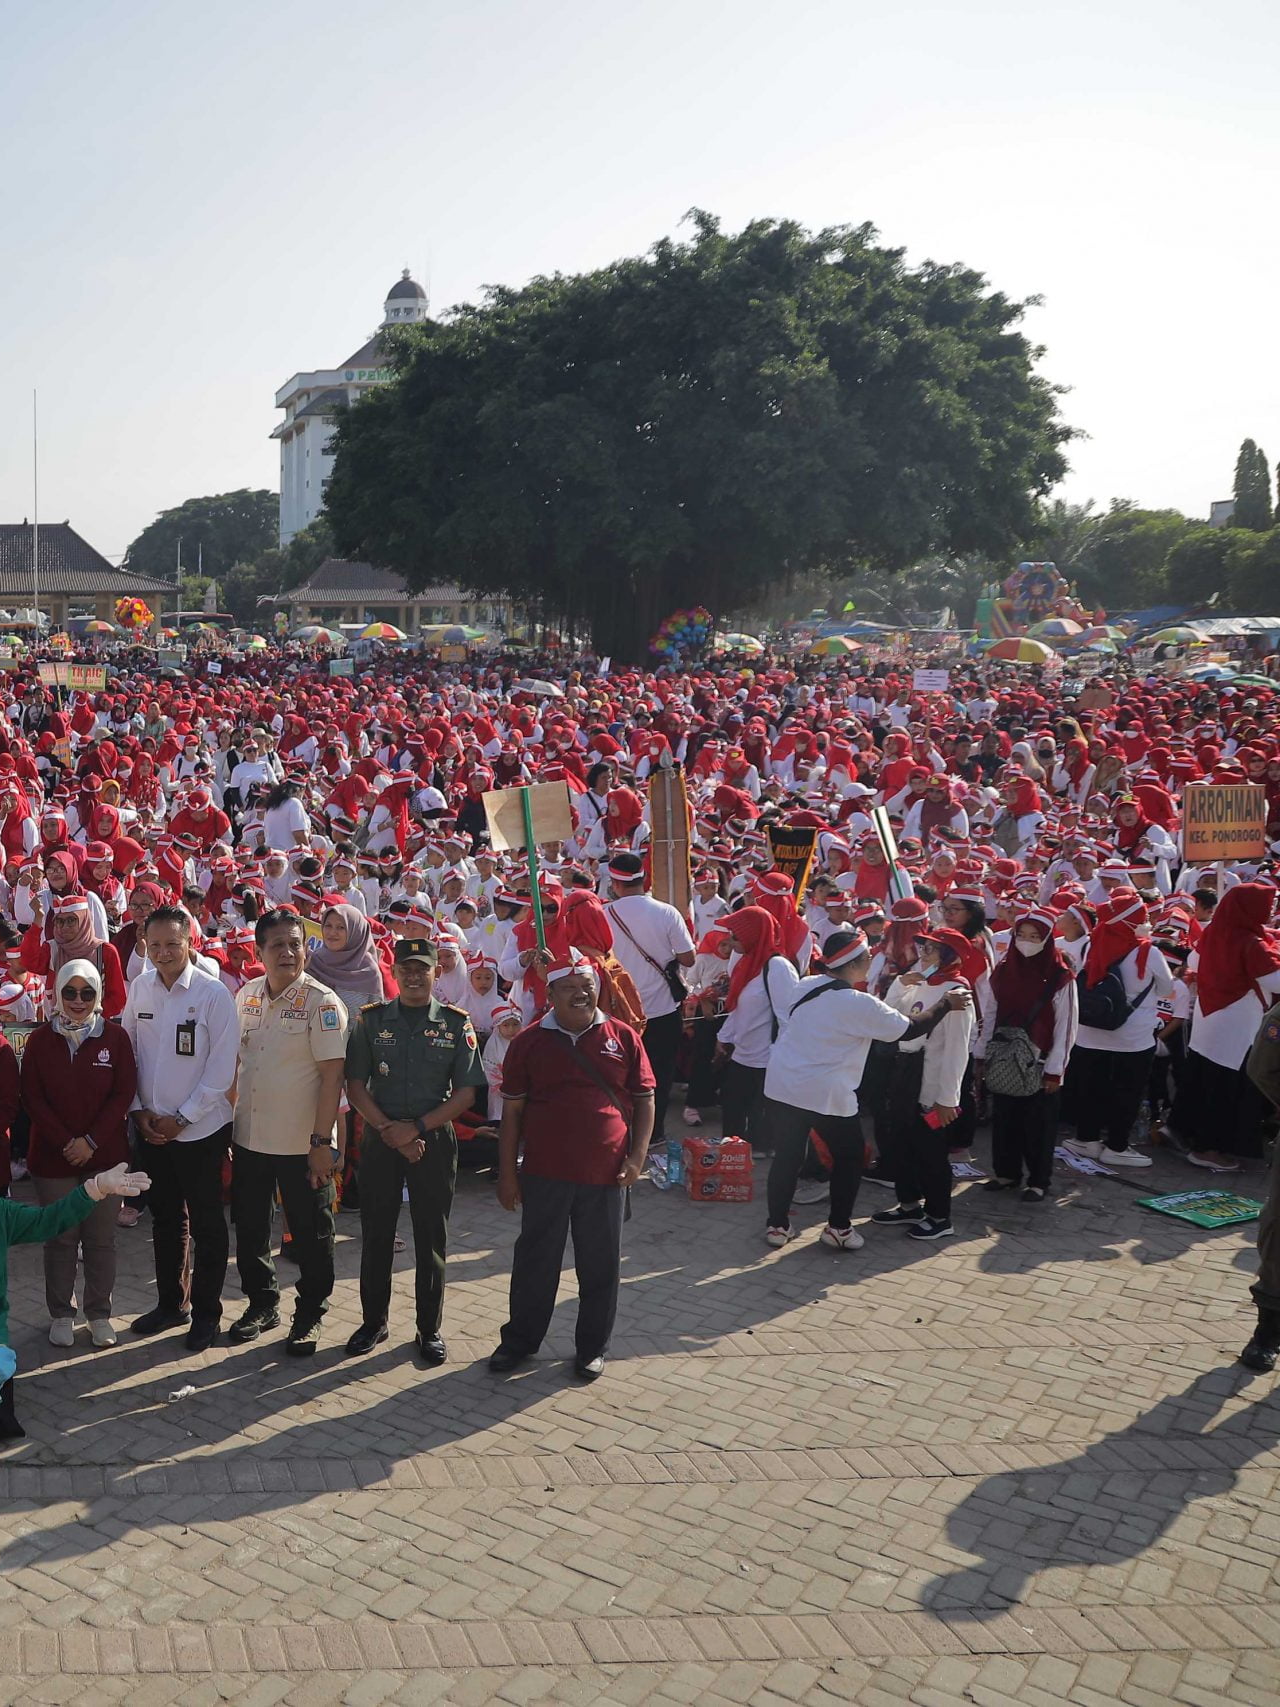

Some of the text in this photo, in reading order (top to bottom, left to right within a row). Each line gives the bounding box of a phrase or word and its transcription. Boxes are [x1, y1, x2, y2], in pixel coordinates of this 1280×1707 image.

[1189, 789, 1264, 823] ARROHMAN
[1190, 829, 1261, 843] KEC. PONOROGO
